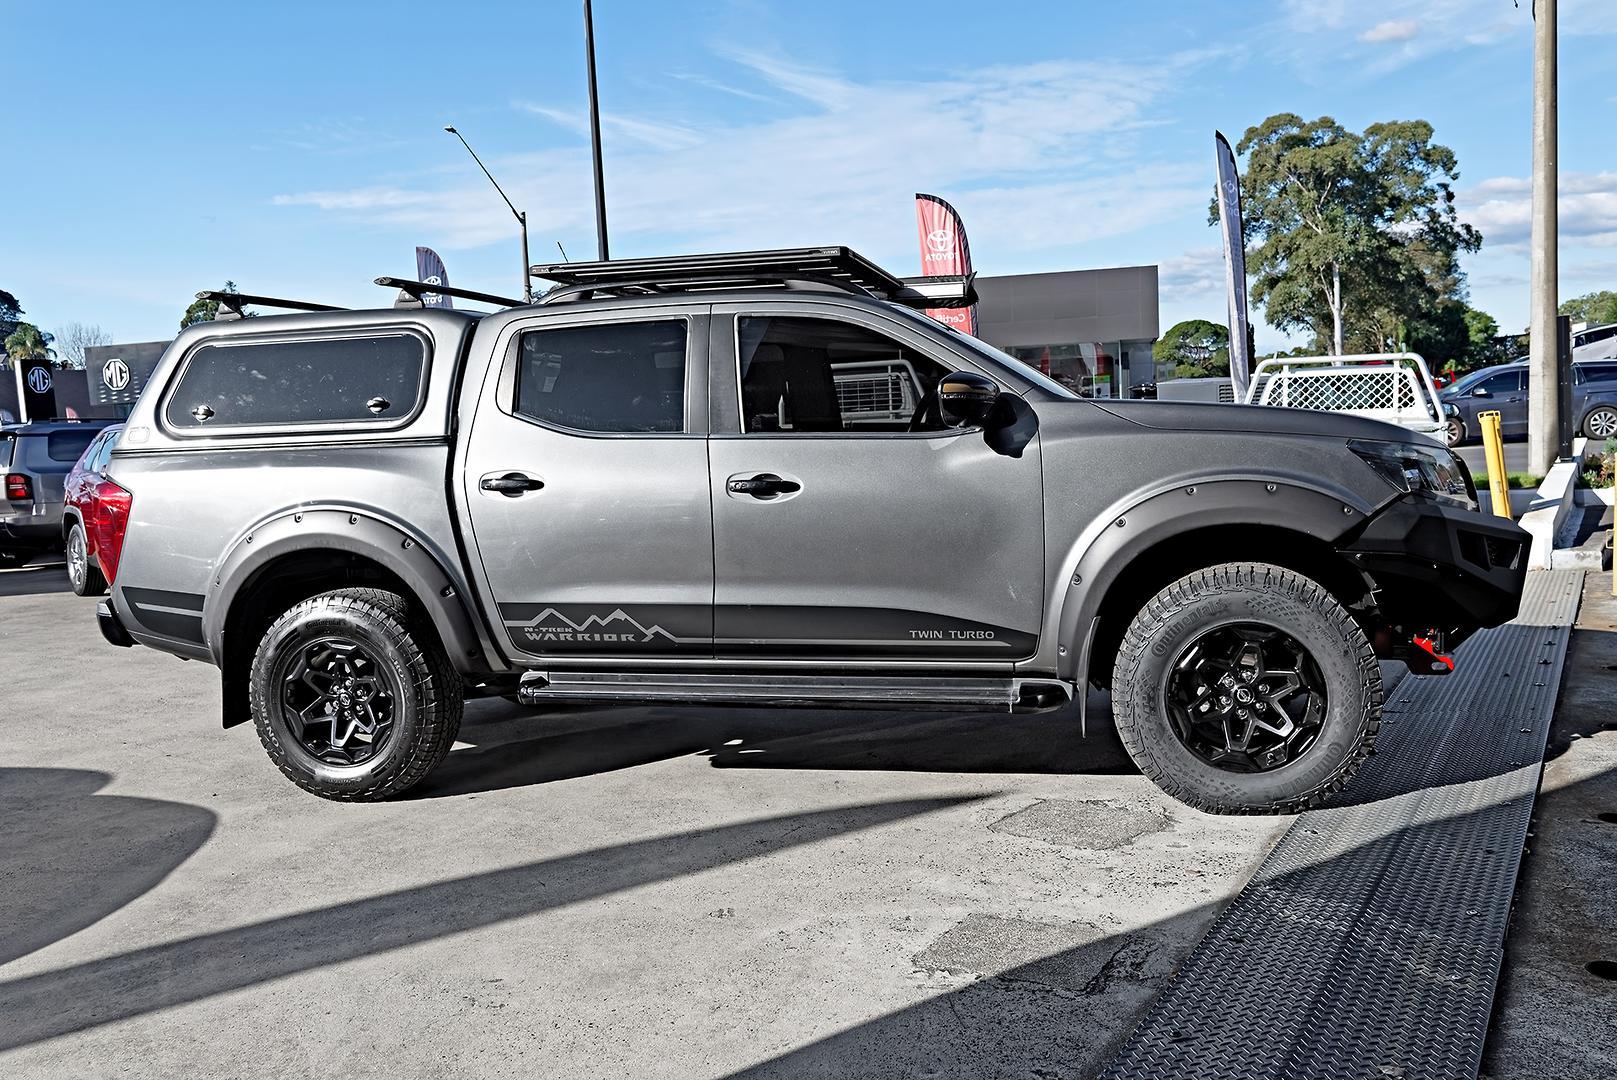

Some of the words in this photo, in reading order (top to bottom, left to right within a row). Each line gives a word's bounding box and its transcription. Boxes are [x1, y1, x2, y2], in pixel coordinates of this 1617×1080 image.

[30, 368, 50, 391] MG
[105, 361, 128, 388] MG
[525, 633, 636, 642] WARRIOR
[909, 630, 943, 639] TWIN
[949, 630, 995, 639] TURBO
